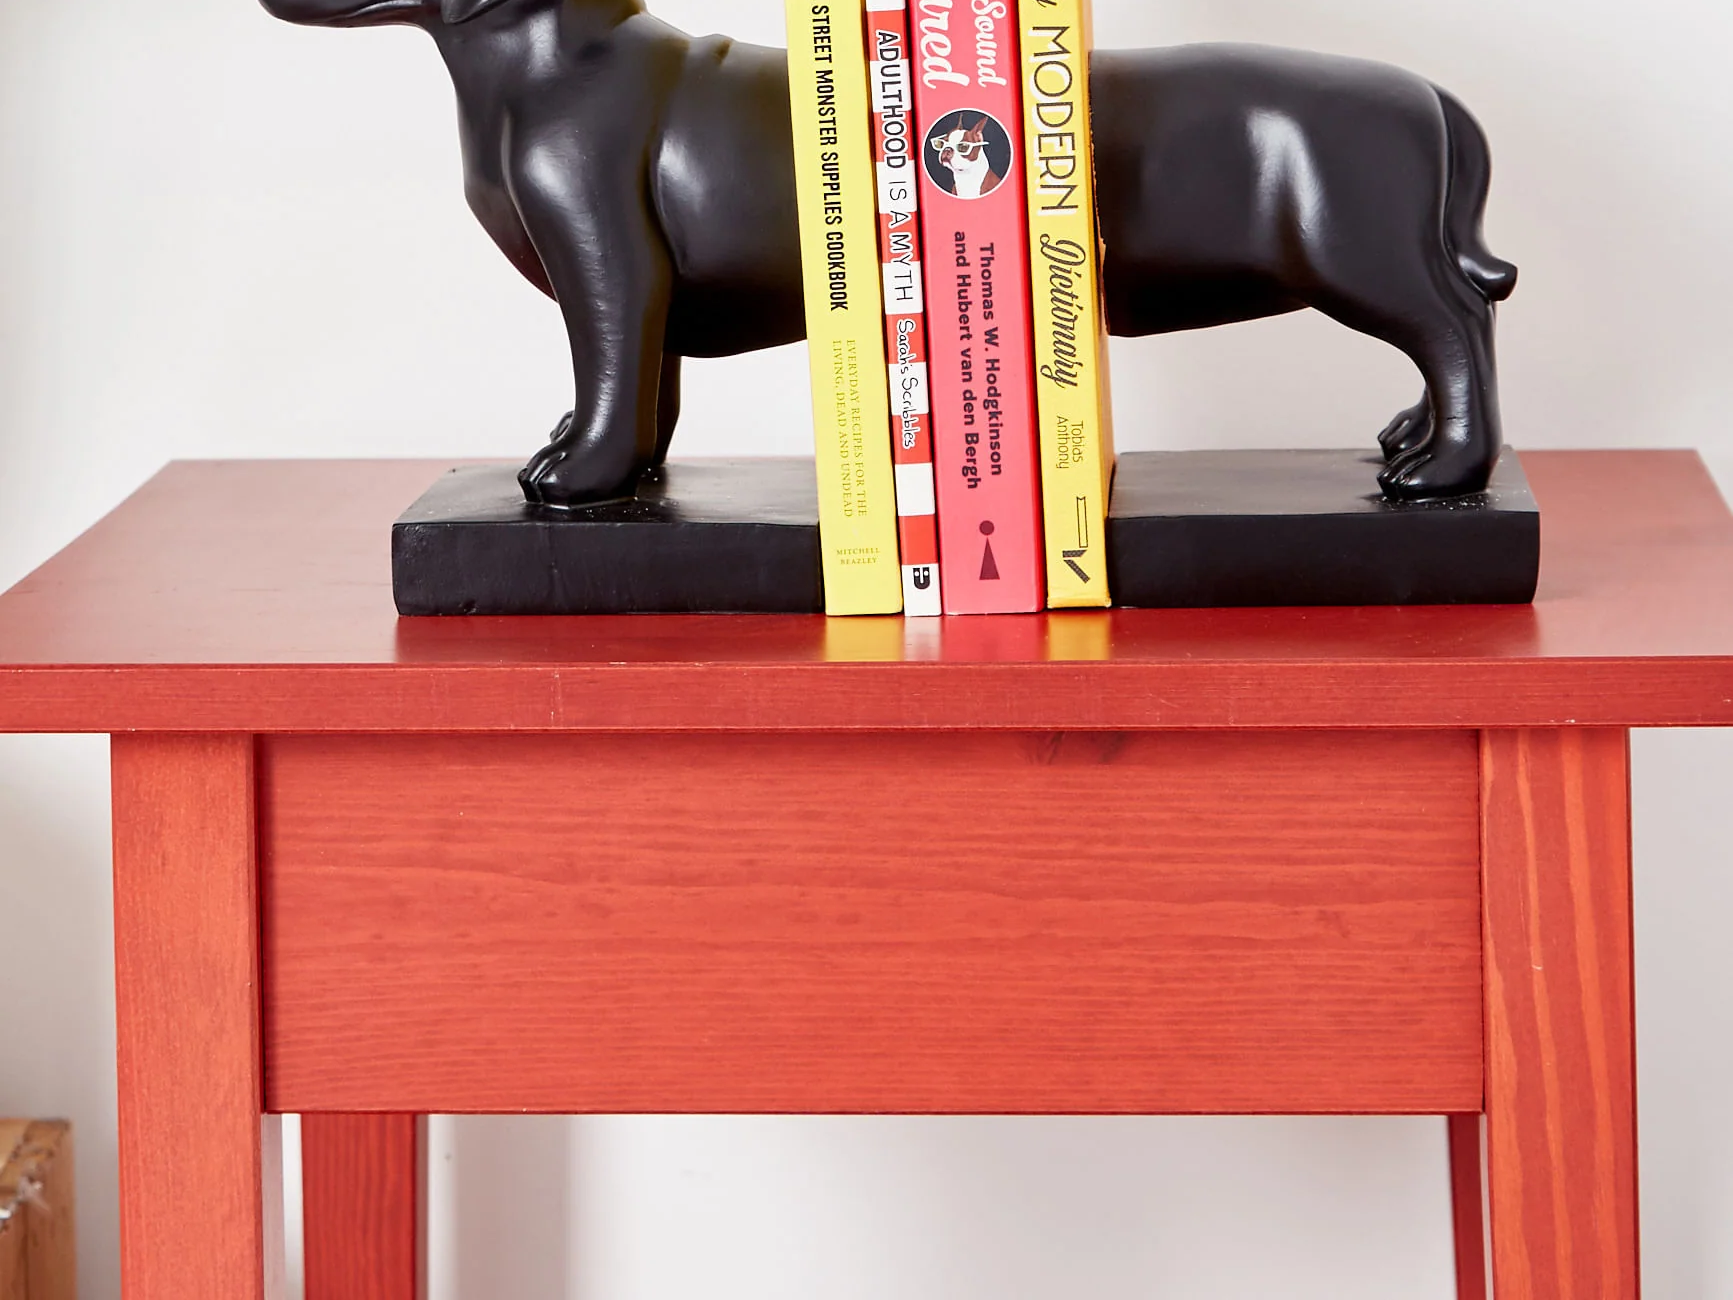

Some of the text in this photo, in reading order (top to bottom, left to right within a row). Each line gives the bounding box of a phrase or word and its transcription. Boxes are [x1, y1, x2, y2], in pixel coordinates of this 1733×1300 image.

[812, 5, 832, 63] STREET
[815, 69, 838, 145] MONSTER
[1030, 25, 1079, 212] MODERN
[821, 152, 843, 225] SUPPLIES
[878, 31, 914, 301] ADULTHOOD IS A MYTH
[826, 231, 848, 311] COOKBOOK
[1039, 233, 1086, 390] Dictionary
[899, 320, 919, 447] Sarah's Scribbles
[954, 231, 981, 489] and Hubert van den Bergh
[980, 242, 1004, 476] Thomas W. Hodgkinson
[836, 392, 847, 427] DEAD
[839, 431, 849, 458] AND
[847, 340, 867, 516] EVERYDAY RECIPES FOR THE
[1056, 415, 1070, 470] Anthony
[1071, 420, 1084, 463] Tobias
[841, 463, 853, 517] UNDEAD
[837, 547, 880, 555] MITCHELL
[840, 557, 877, 565] BEAZLEY
